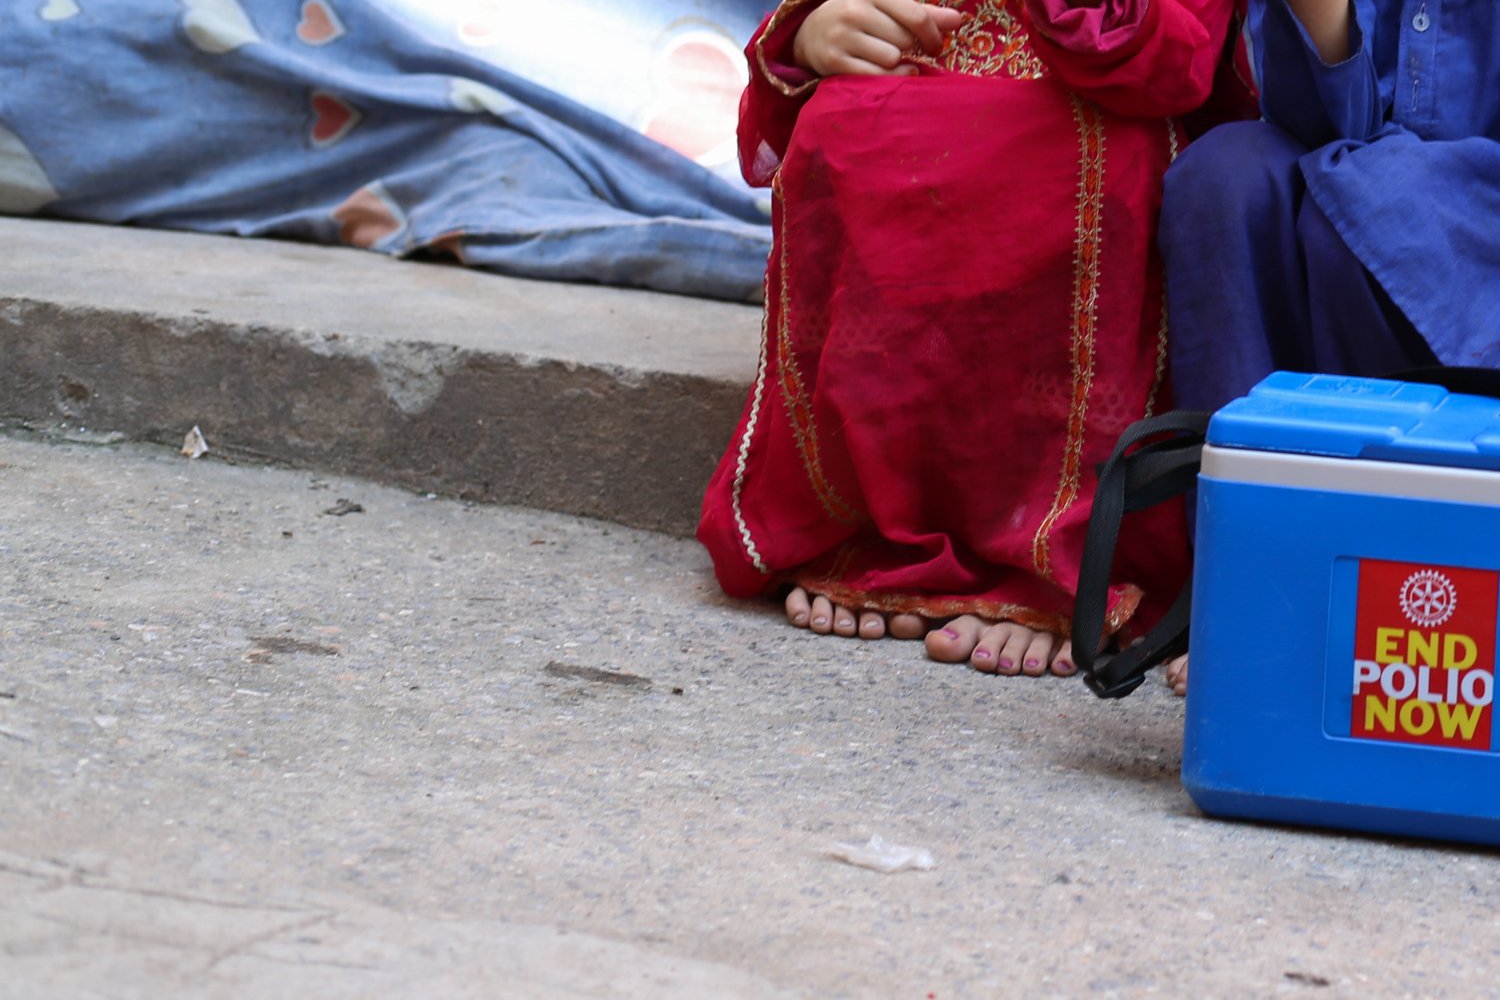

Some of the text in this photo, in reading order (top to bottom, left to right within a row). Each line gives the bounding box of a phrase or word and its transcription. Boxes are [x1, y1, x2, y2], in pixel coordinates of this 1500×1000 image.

[1375, 627, 1478, 670] END
[1353, 659, 1494, 707] POLIO
[1364, 695, 1483, 740] NOW
